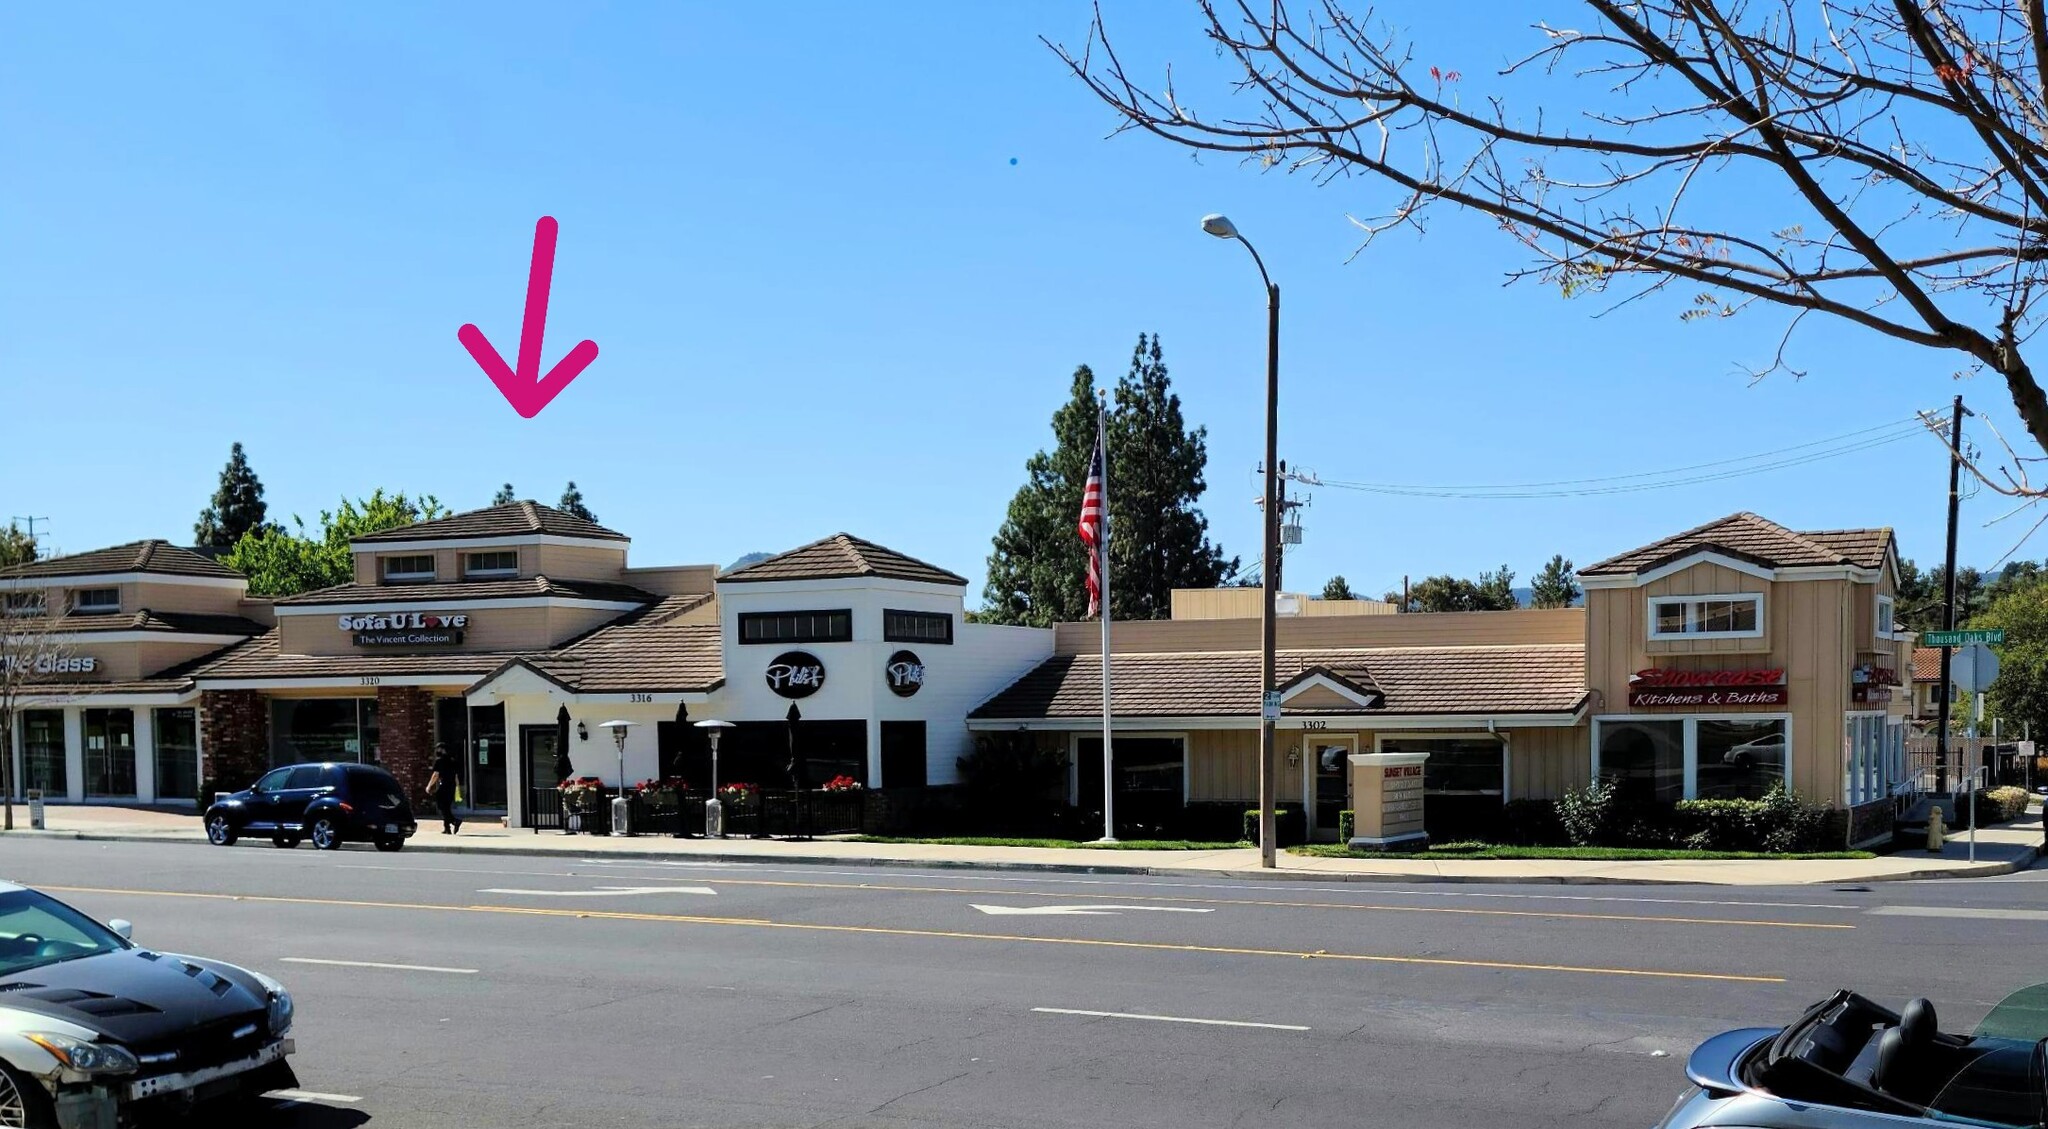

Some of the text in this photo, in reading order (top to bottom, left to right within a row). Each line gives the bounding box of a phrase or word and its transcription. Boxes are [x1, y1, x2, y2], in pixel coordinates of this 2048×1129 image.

[338, 614, 387, 631] Sofa
[390, 613, 407, 629] U
[360, 633, 450, 645] The Vincent Collection
[1927, 631, 2002, 644] Thousand Oaks Blvd
[37, 654, 95, 673] Glass
[360, 677, 380, 686] 3320
[630, 693, 653, 703] 3316
[1634, 691, 1779, 706] Kitchens & Baths
[1302, 720, 1327, 730] 3302
